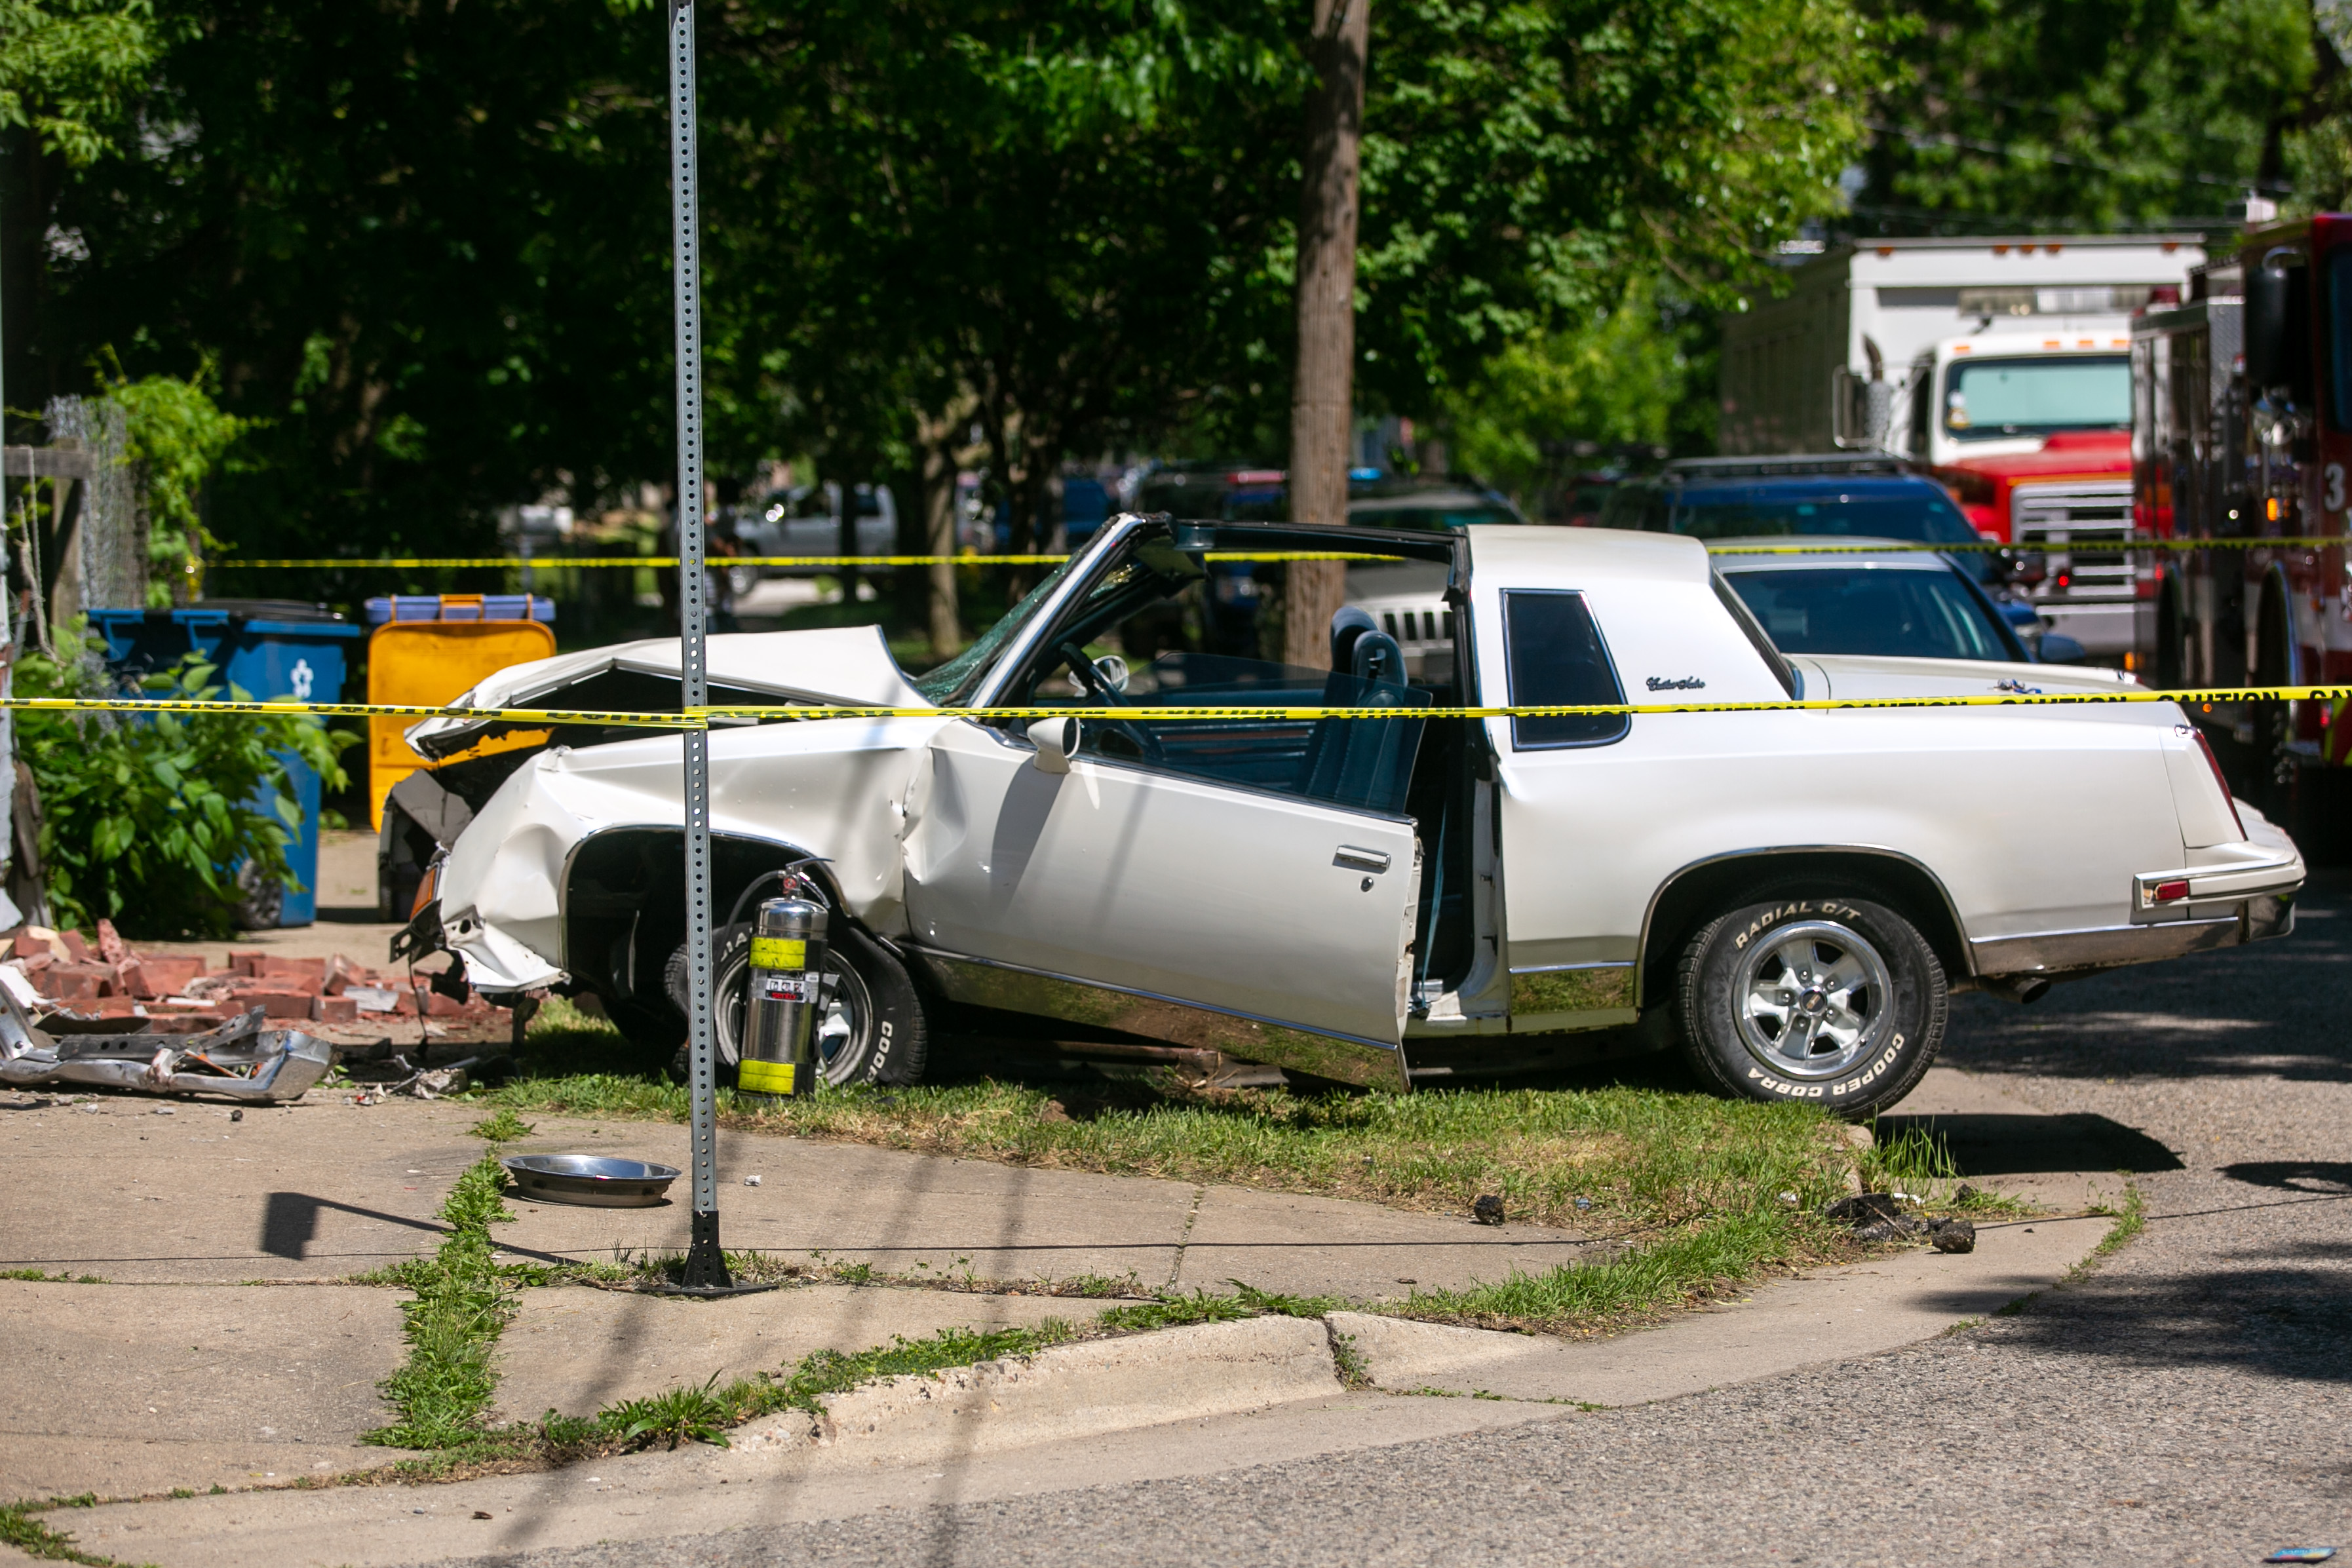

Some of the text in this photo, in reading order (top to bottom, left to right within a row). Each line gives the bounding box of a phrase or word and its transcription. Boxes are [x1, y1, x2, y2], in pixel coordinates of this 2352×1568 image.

[2324, 462, 2345, 512] 3
[1735, 902, 1861, 949] RADIAL G/T
[1747, 1033, 1904, 1097] COOPER COBRA
